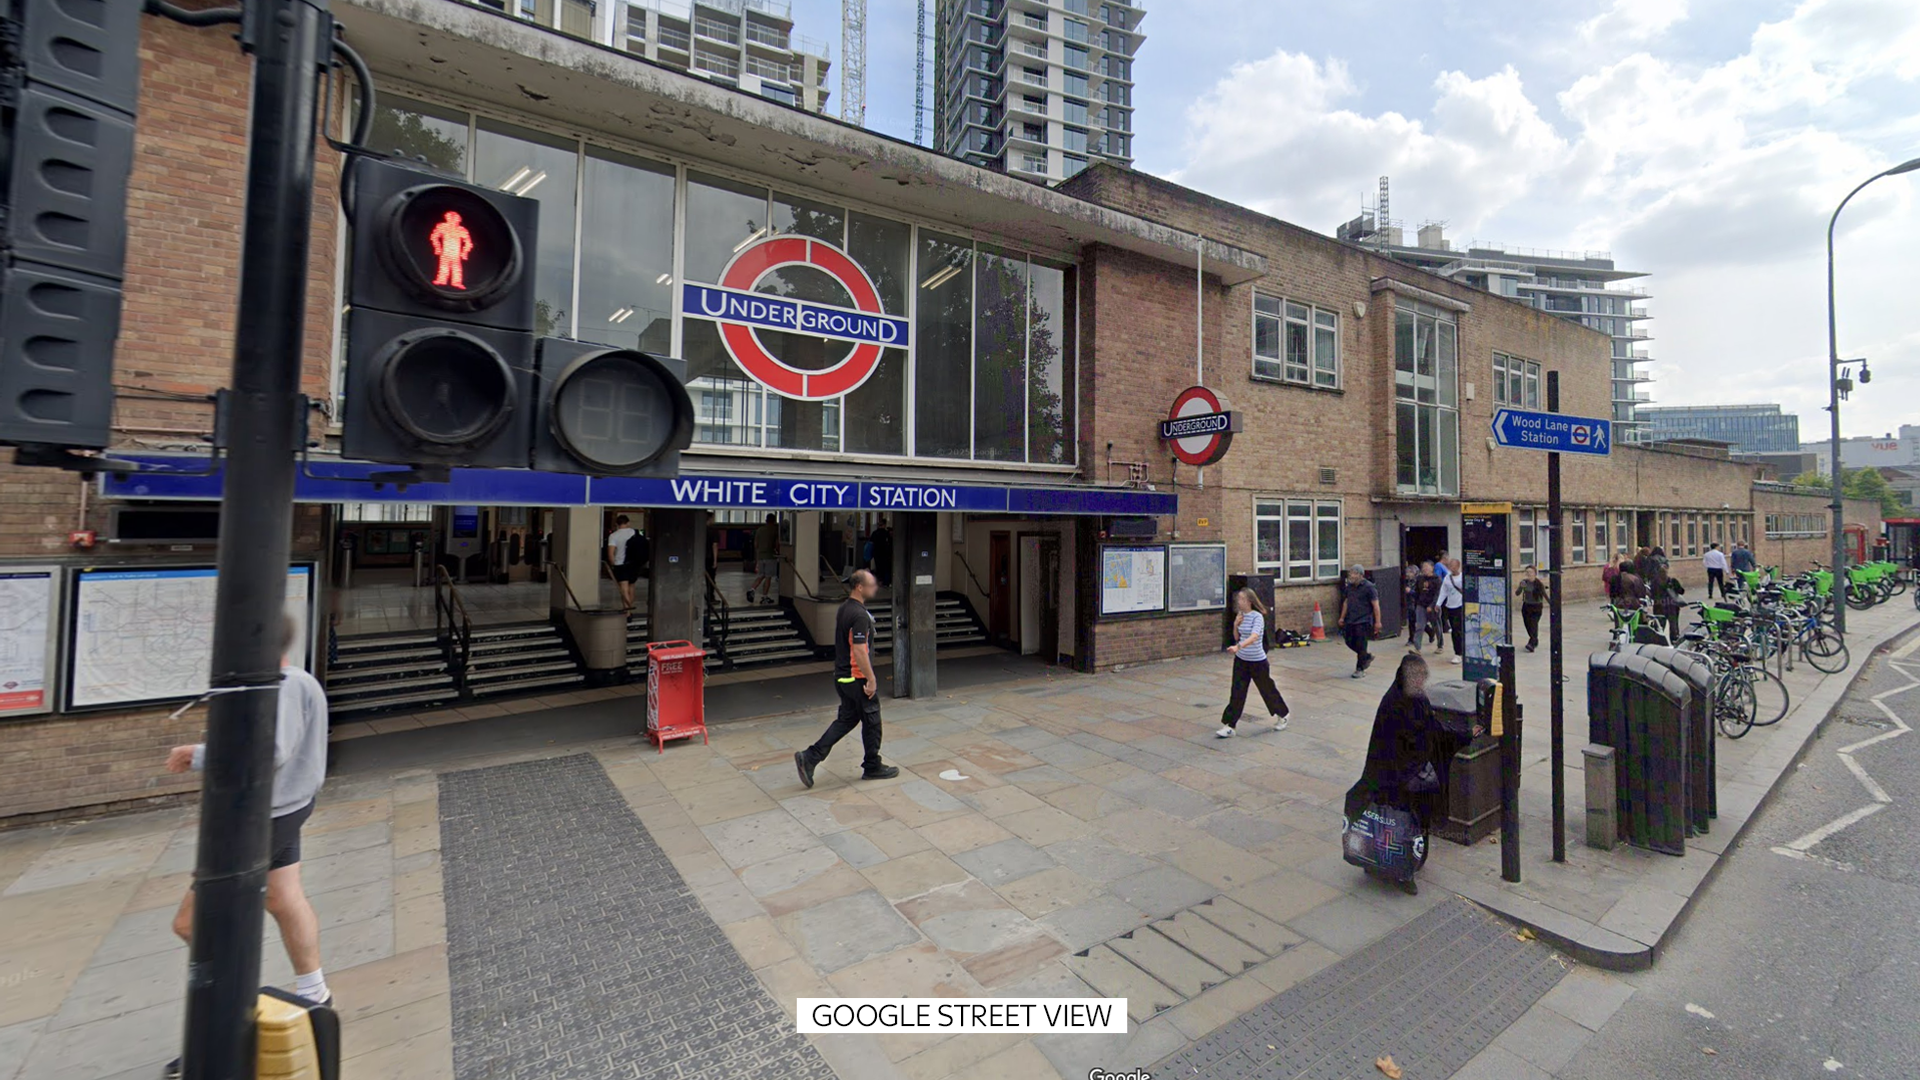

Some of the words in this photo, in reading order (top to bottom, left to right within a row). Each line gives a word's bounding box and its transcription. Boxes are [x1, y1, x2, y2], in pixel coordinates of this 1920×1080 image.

[701, 289, 897, 342] UNDERGROUND
[1163, 414, 1228, 436] UNDERGROUND
[1511, 415, 1541, 429] Wood
[1545, 419, 1568, 432] Lane
[1521, 430, 1559, 444] Station
[670, 479, 767, 503] WHITE
[789, 483, 849, 505] CITY
[869, 486, 956, 507] STATION
[661, 661, 683, 671] FREE
